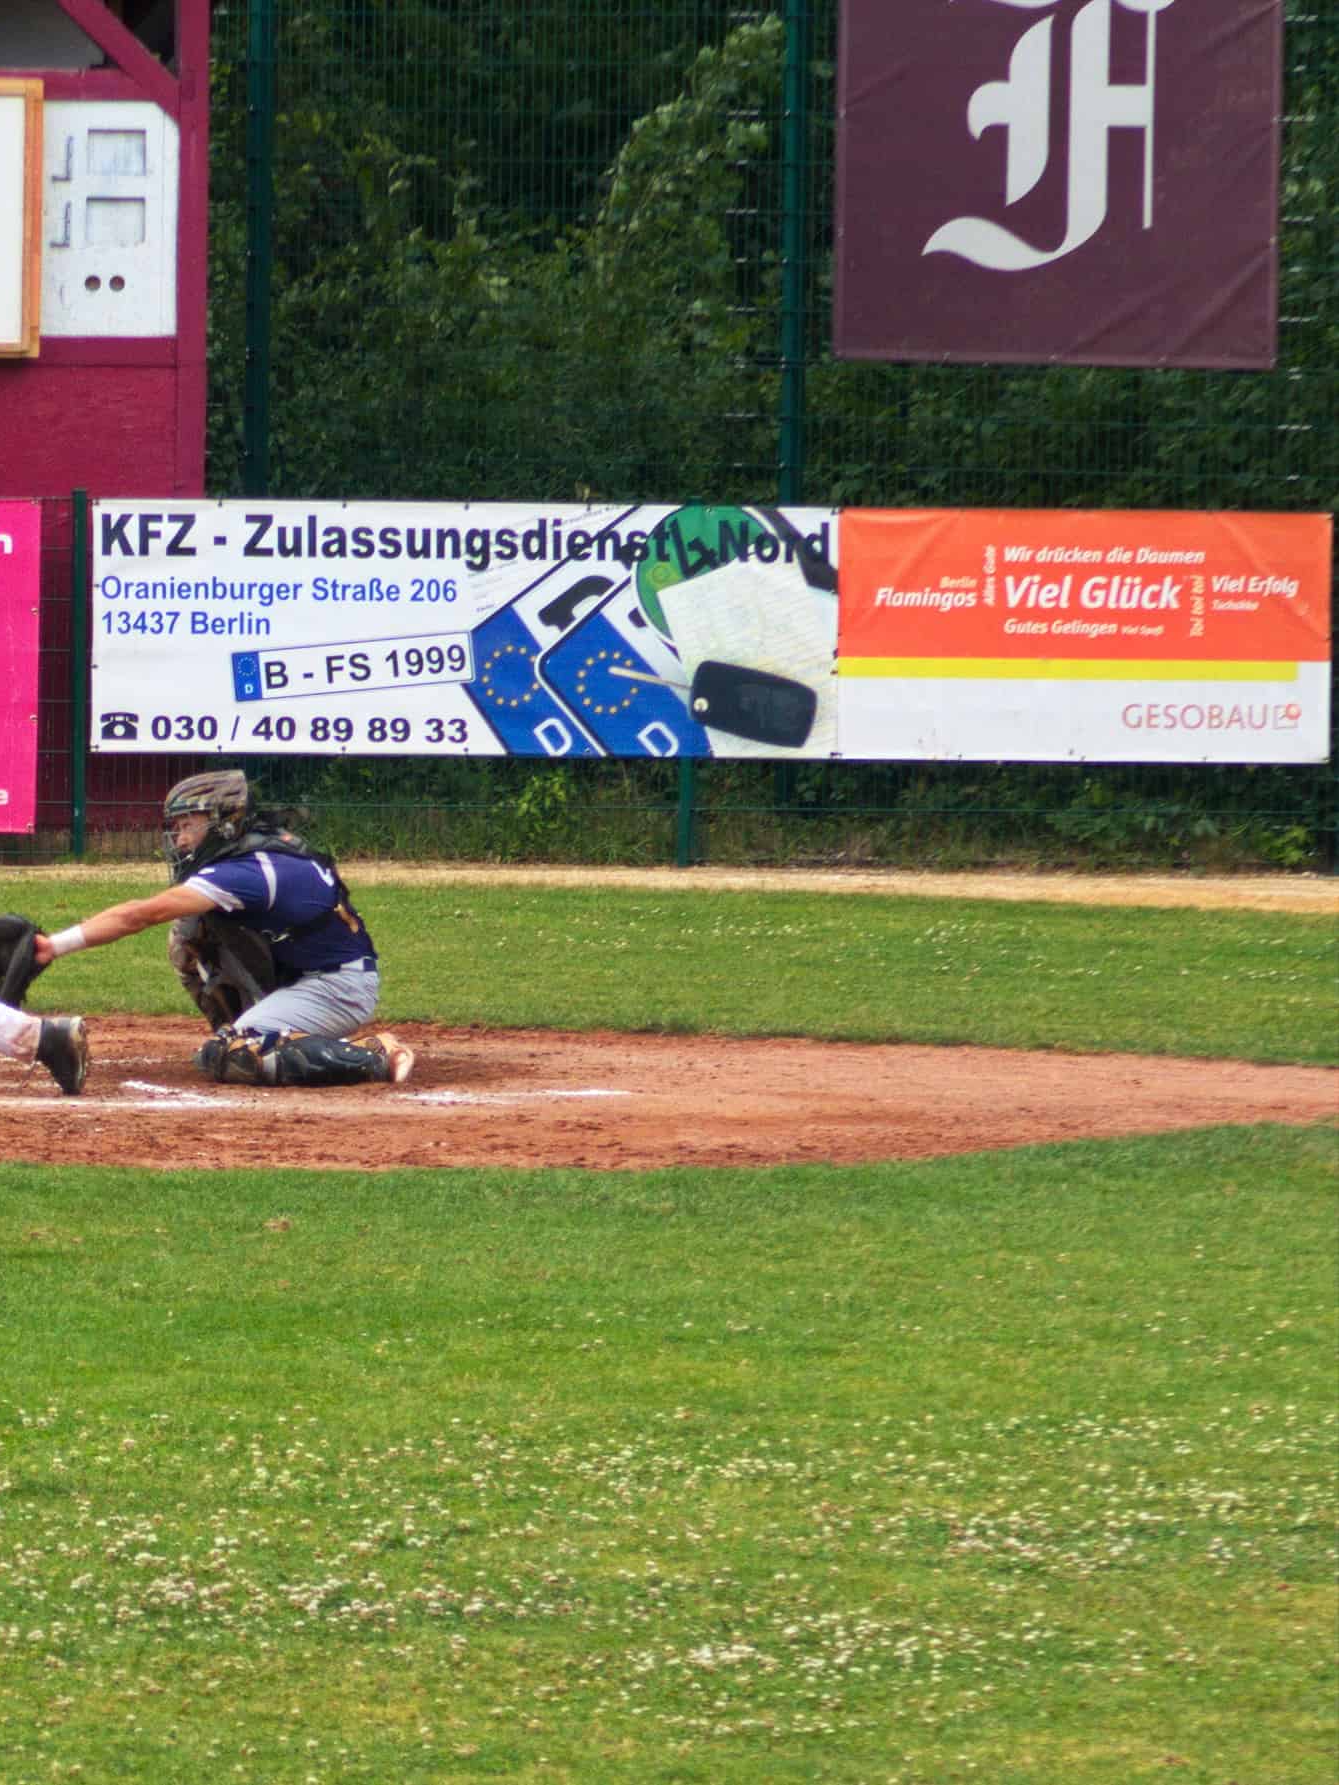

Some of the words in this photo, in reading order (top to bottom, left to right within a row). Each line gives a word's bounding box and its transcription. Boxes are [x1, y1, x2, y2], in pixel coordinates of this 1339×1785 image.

[100, 513, 198, 557] KFZ
[243, 514, 670, 571] Zulassungsdienst
[718, 519, 830, 564] Nord
[1004, 546, 1033, 563] Wir
[1036, 546, 1102, 564] drücken
[1105, 546, 1133, 564] die
[1135, 547, 1207, 565] Daumen
[100, 575, 303, 606] Oranienburger
[312, 577, 401, 602] Straße
[411, 578, 458, 602] 206
[939, 576, 978, 589] Berlin
[1005, 574, 1073, 609] Viel
[1081, 574, 1183, 610] Glück
[1211, 575, 1246, 593] Viel
[1247, 575, 1301, 598] Erfolg
[874, 586, 977, 613] Flamingos
[101, 611, 181, 635] 13437
[191, 611, 271, 635] Berlin
[1004, 618, 1049, 635] Gutes
[1051, 617, 1118, 639] Gelingen
[264, 660, 290, 690] B
[325, 652, 372, 684] FS
[384, 643, 467, 678] 1999
[150, 714, 219, 741] 030
[251, 714, 297, 742] 40
[309, 717, 354, 743] 89
[367, 717, 412, 744] 89
[424, 718, 469, 745] 33
[1121, 703, 1269, 730] GESOBAU
